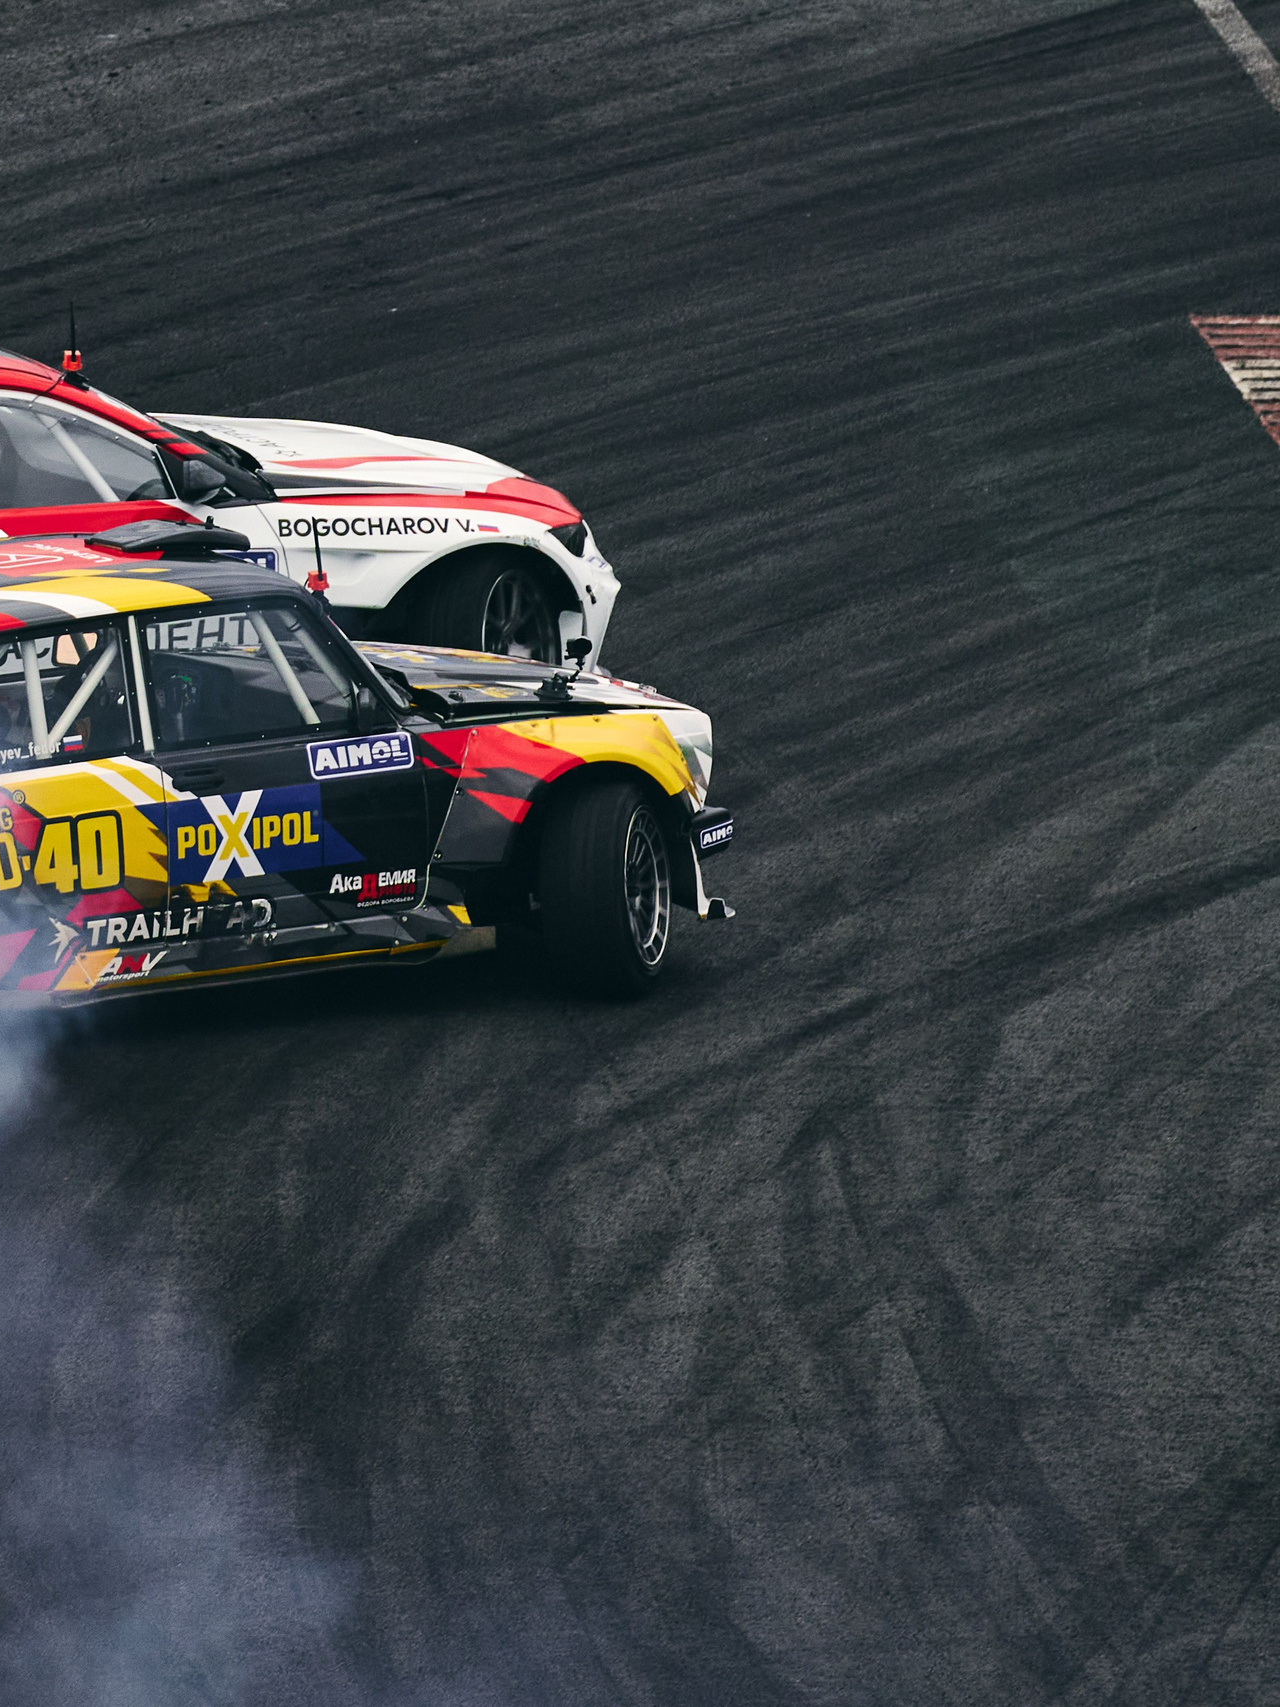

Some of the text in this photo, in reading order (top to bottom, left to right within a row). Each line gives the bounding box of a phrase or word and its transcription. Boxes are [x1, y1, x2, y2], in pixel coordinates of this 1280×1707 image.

[278, 517, 475, 537] BOGOCHAROV V.
[314, 738, 409, 772] AIMOL
[177, 789, 320, 883] POXIPOL
[86, 898, 273, 947] TRAILHAD
